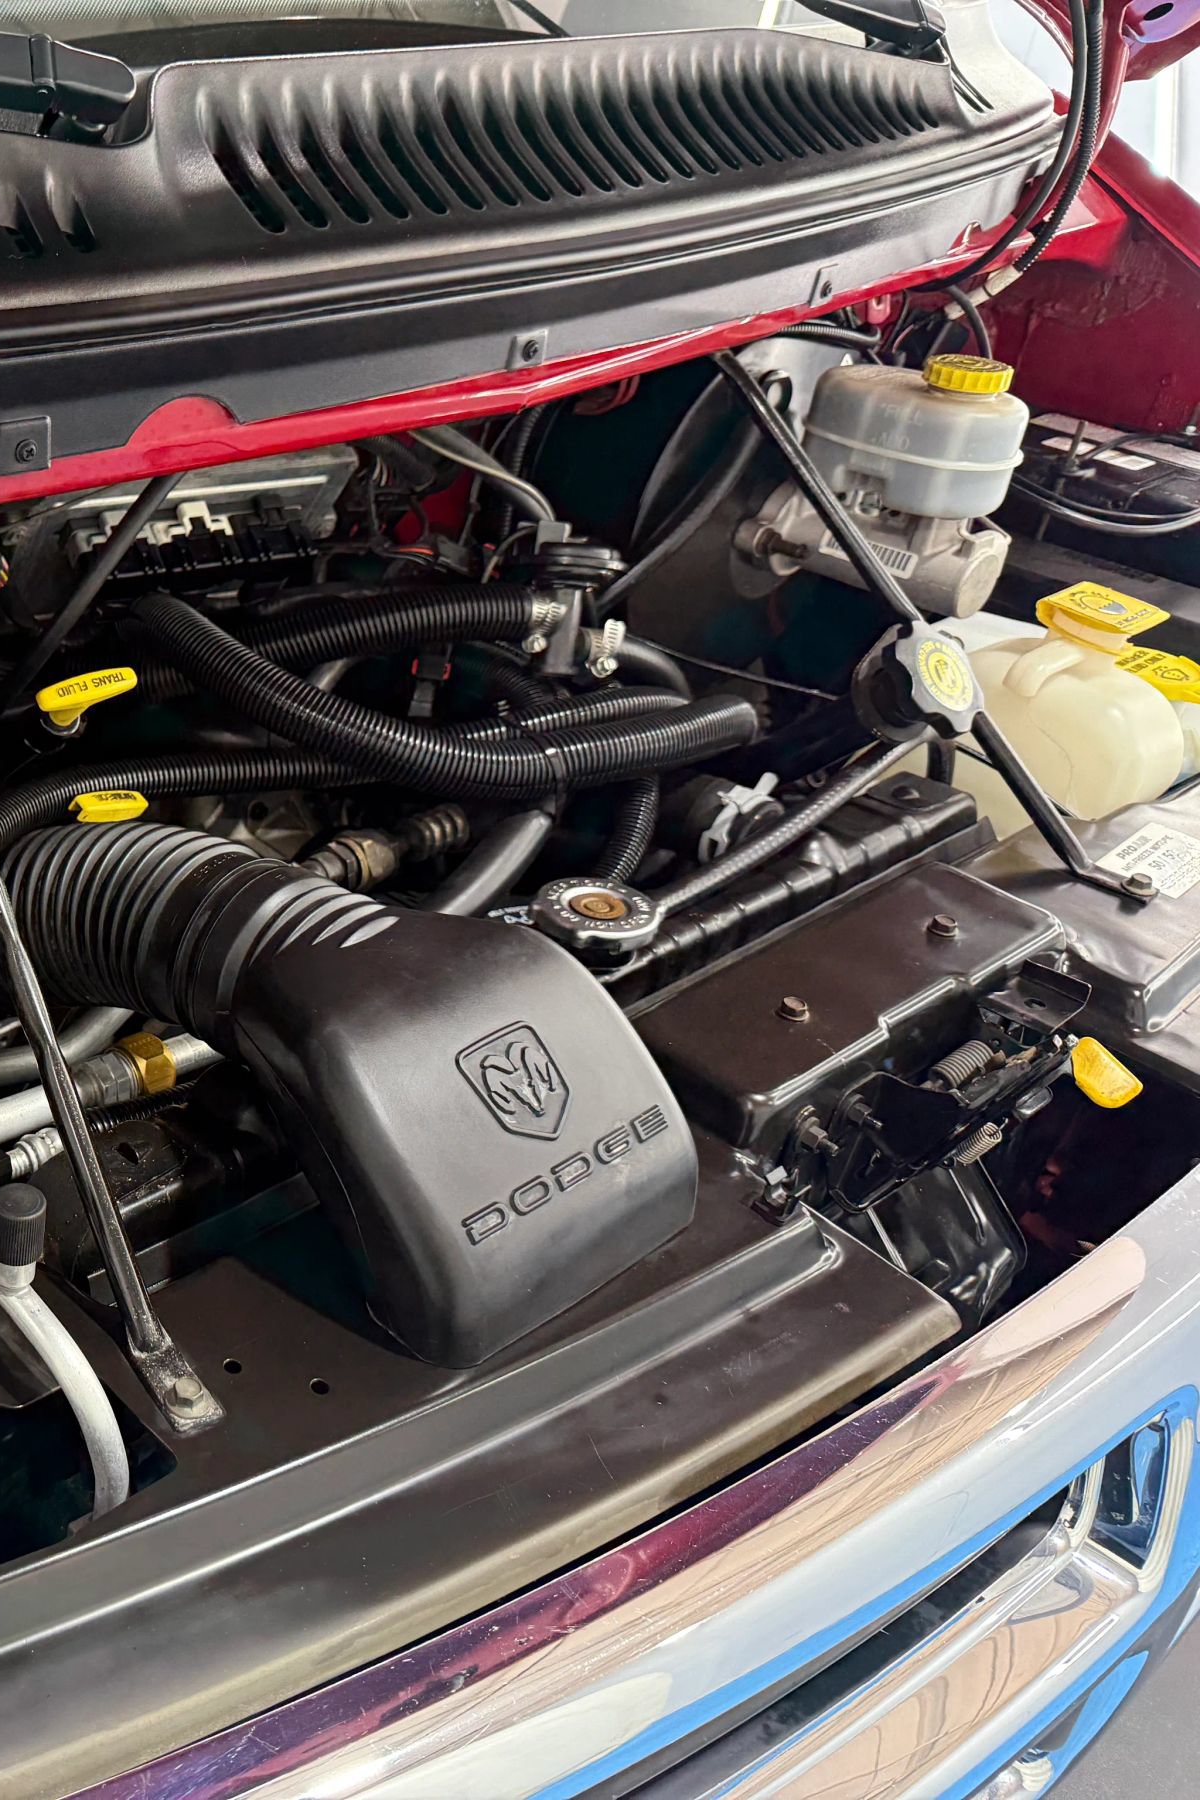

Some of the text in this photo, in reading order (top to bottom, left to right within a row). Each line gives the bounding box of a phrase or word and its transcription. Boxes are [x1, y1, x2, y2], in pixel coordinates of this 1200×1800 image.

[56, 671, 126, 698] TRANS FLUID
[461, 1103, 669, 1246] DODGE
